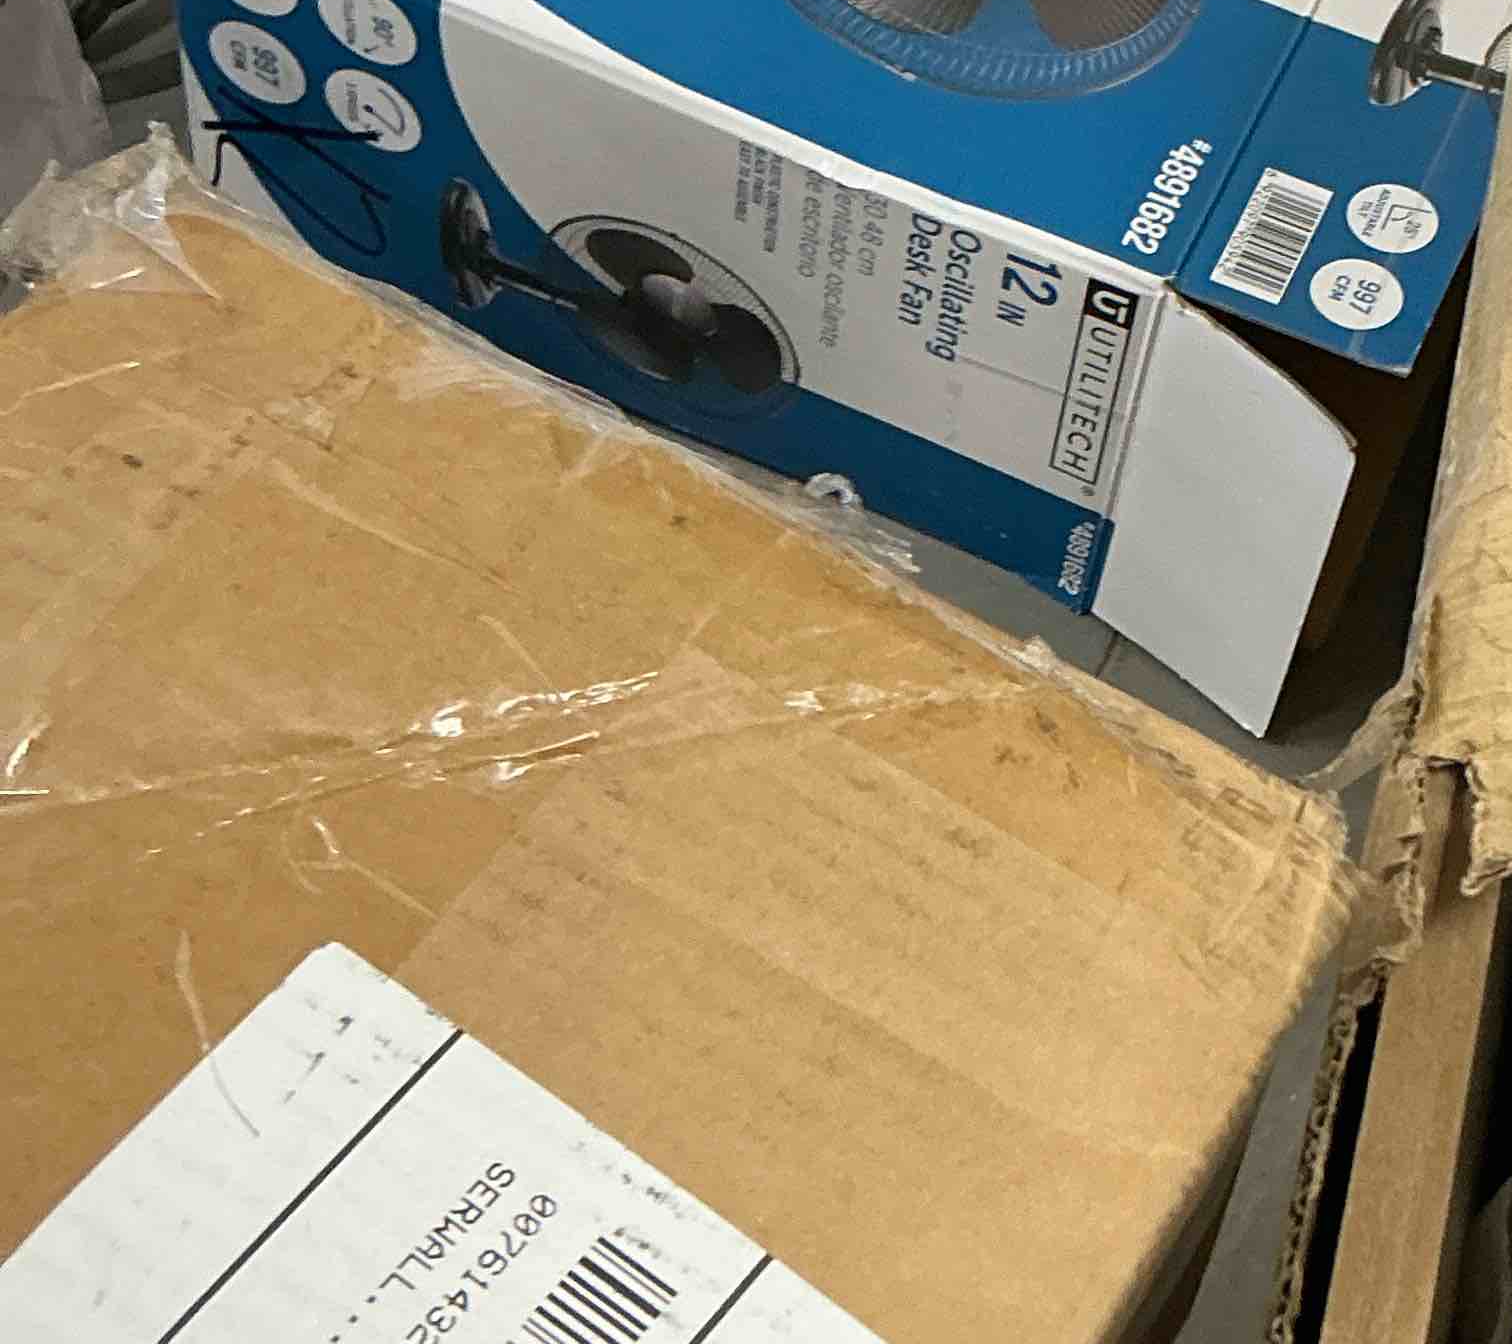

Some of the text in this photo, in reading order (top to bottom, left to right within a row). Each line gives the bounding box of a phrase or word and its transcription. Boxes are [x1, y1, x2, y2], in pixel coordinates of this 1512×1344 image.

[898, 212, 944, 326] Desk Fan
[926, 228, 982, 363] Oscillating
[995, 253, 1063, 327] 12 IN
[1327, 273, 1351, 302] CFM
[1349, 279, 1382, 315] 997
[1066, 327, 1118, 473] UTILITECH
[329, 1162, 516, 1343] SERWALL...
